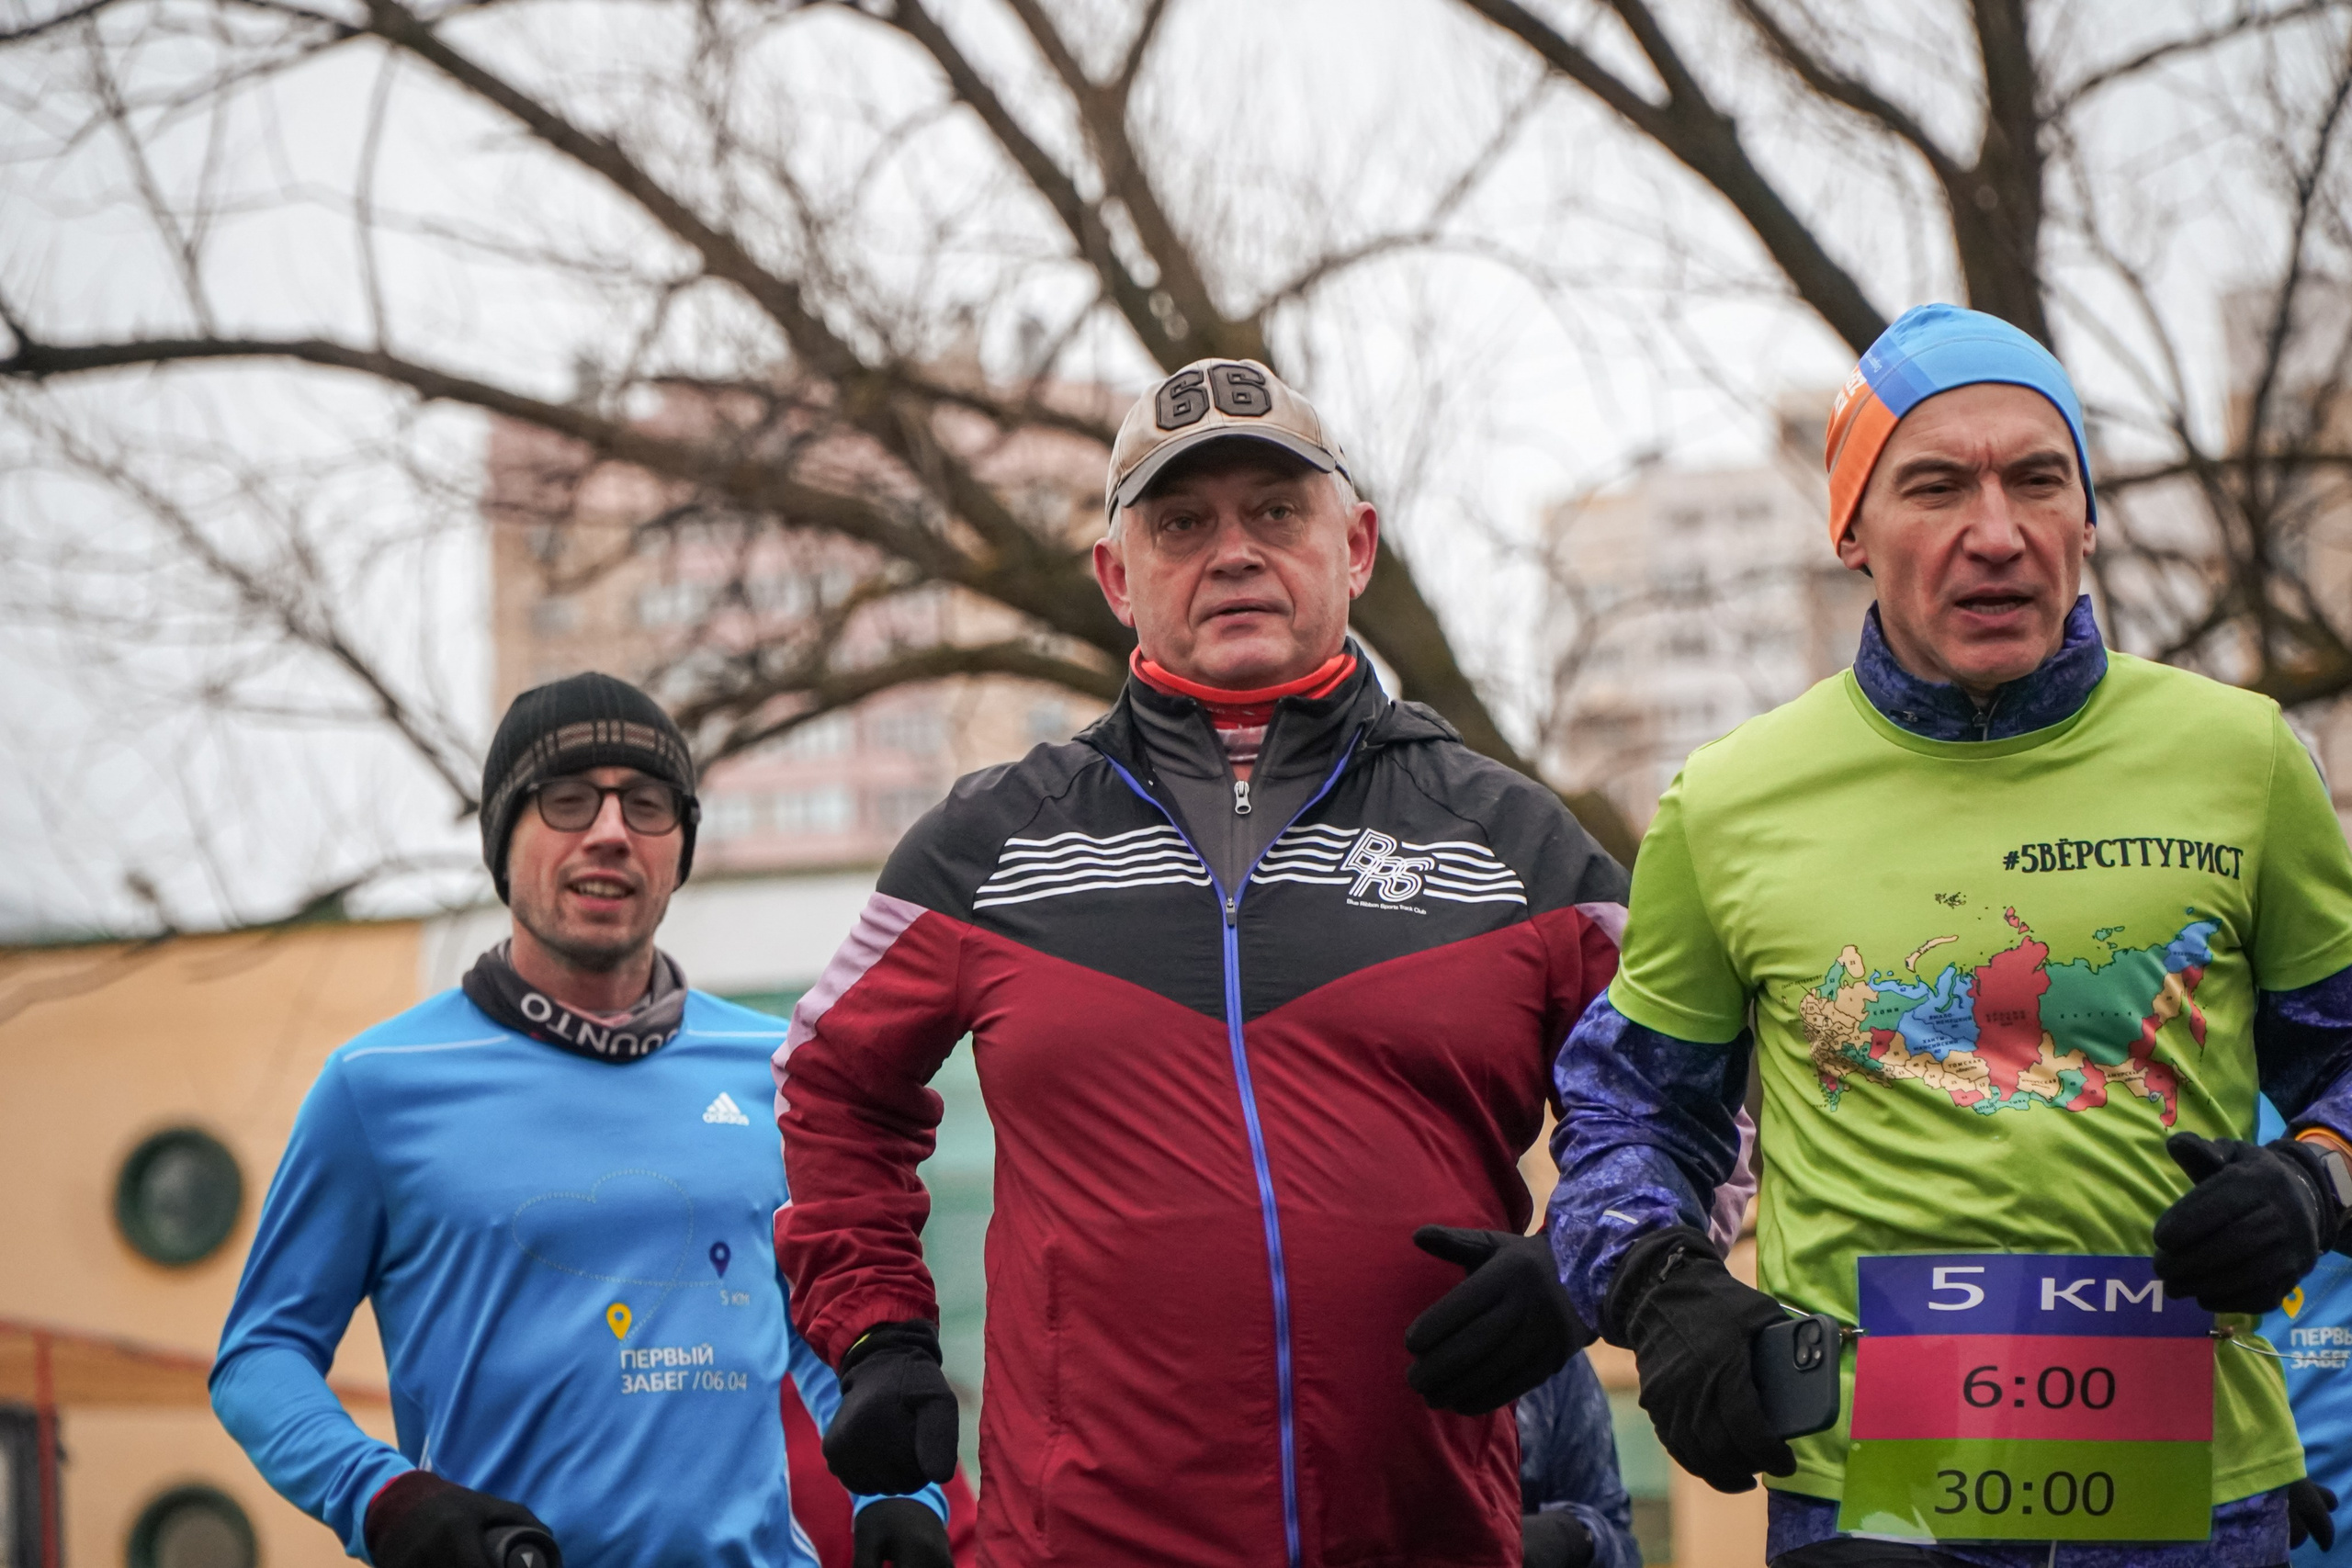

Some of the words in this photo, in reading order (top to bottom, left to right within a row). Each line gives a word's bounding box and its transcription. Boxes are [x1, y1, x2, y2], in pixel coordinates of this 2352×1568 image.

[1155, 364, 1272, 431] 66
[2003, 838, 2244, 880] #5ВЁРСТТУРИСТ
[1346, 898, 1360, 907] Blue
[1399, 904, 1413, 912] Track
[1413, 907, 1427, 915] Club
[719, 1289, 729, 1306] 5
[1928, 1266, 1985, 1312] 5
[620, 1342, 714, 1370] ПЕРВЫЙ
[2290, 1350, 2349, 1370] ЗАБЕГ
[621, 1370, 689, 1394] ЗАБЕГ
[1962, 1365, 2116, 1411] 6:00
[1933, 1470, 2114, 1517] 30:00
